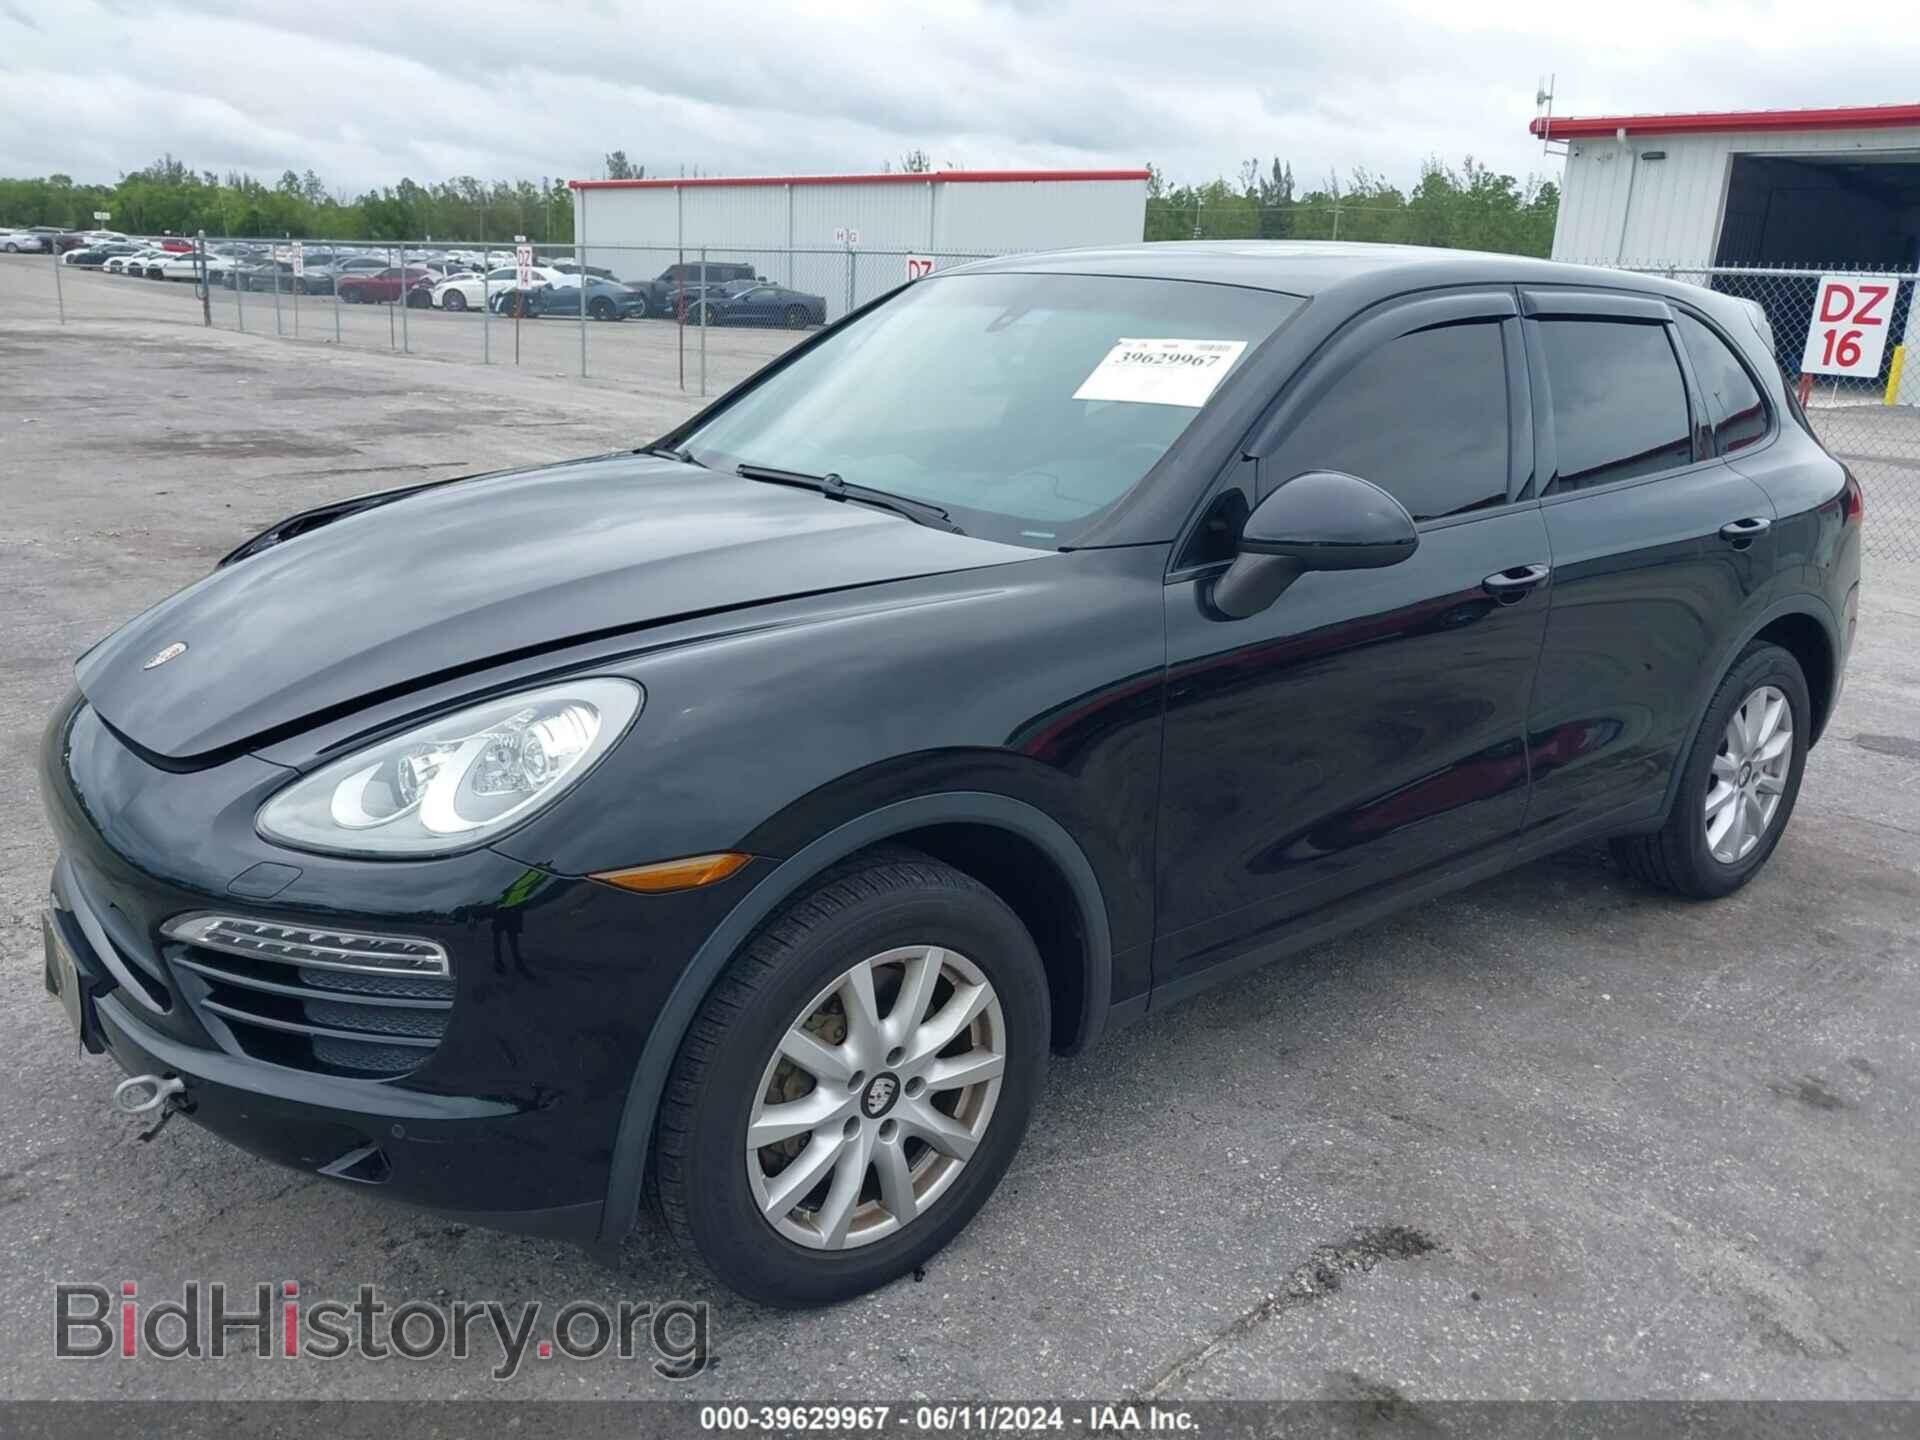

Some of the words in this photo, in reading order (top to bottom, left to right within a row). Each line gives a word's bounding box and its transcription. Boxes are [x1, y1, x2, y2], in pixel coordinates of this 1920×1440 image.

[518, 249, 530, 267] DZ
[1819, 284, 1889, 325] DZ
[1122, 351, 1221, 367] 39629967
[1822, 329, 1863, 367] 16
